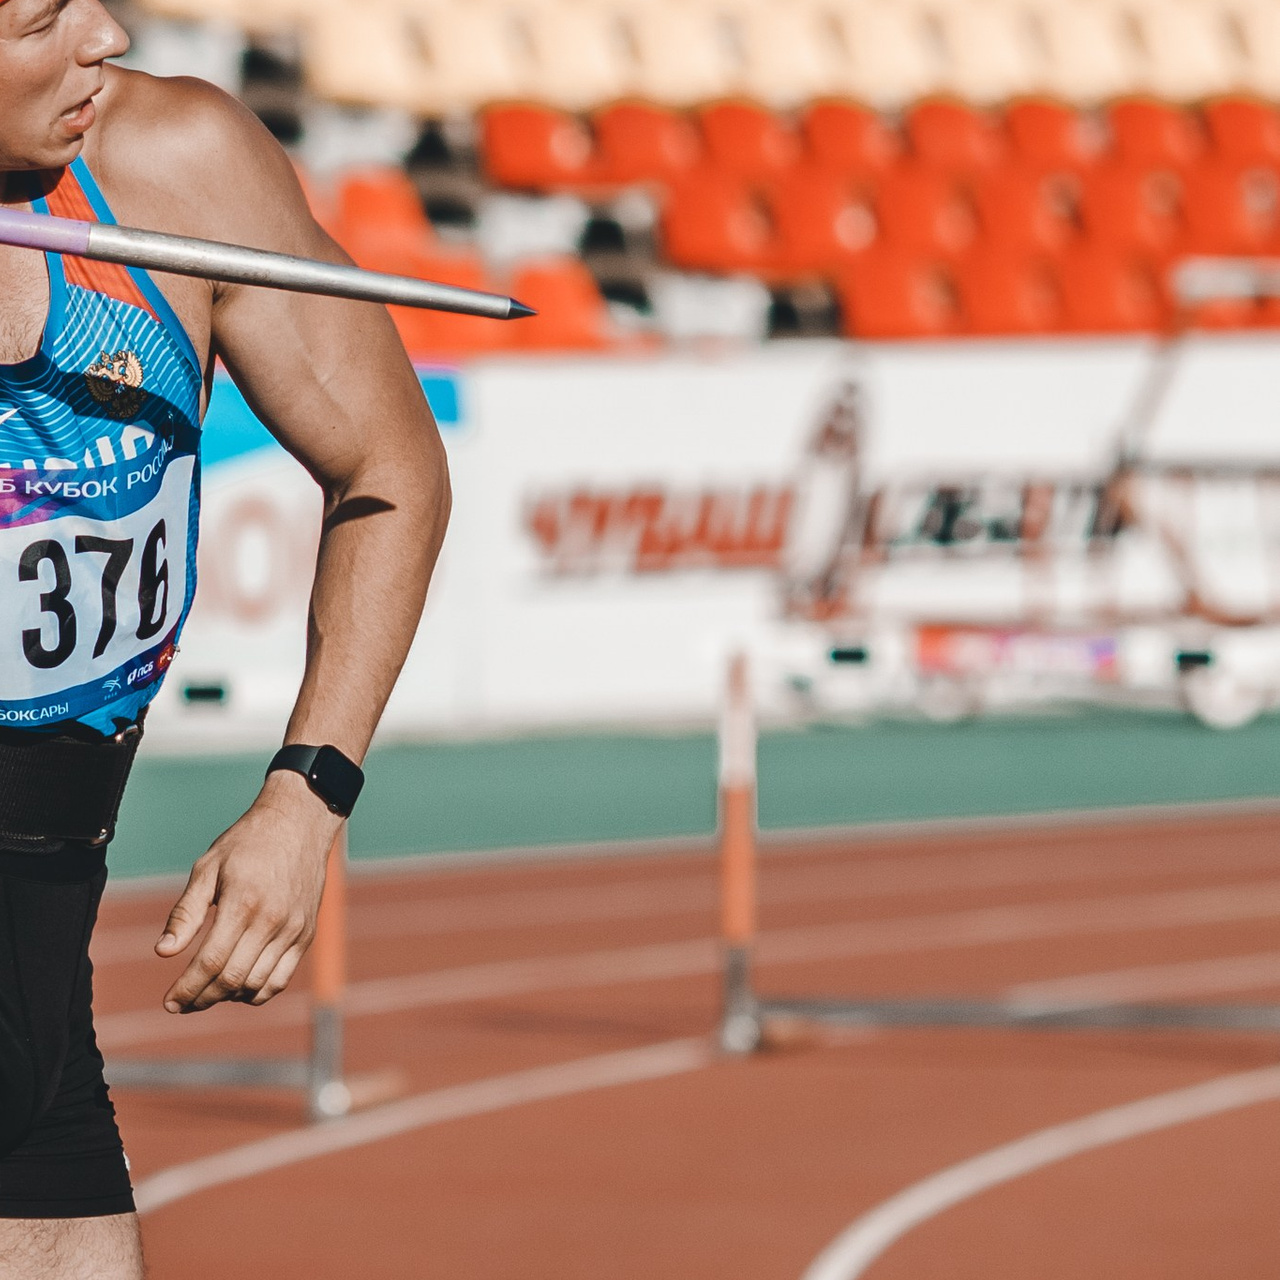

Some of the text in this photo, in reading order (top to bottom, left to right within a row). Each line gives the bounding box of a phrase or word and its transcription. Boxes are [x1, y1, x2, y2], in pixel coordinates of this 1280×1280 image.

[25, 476, 118, 498] КУБОК
[127, 438, 168, 489] РОССИ
[18, 518, 169, 669] 376
